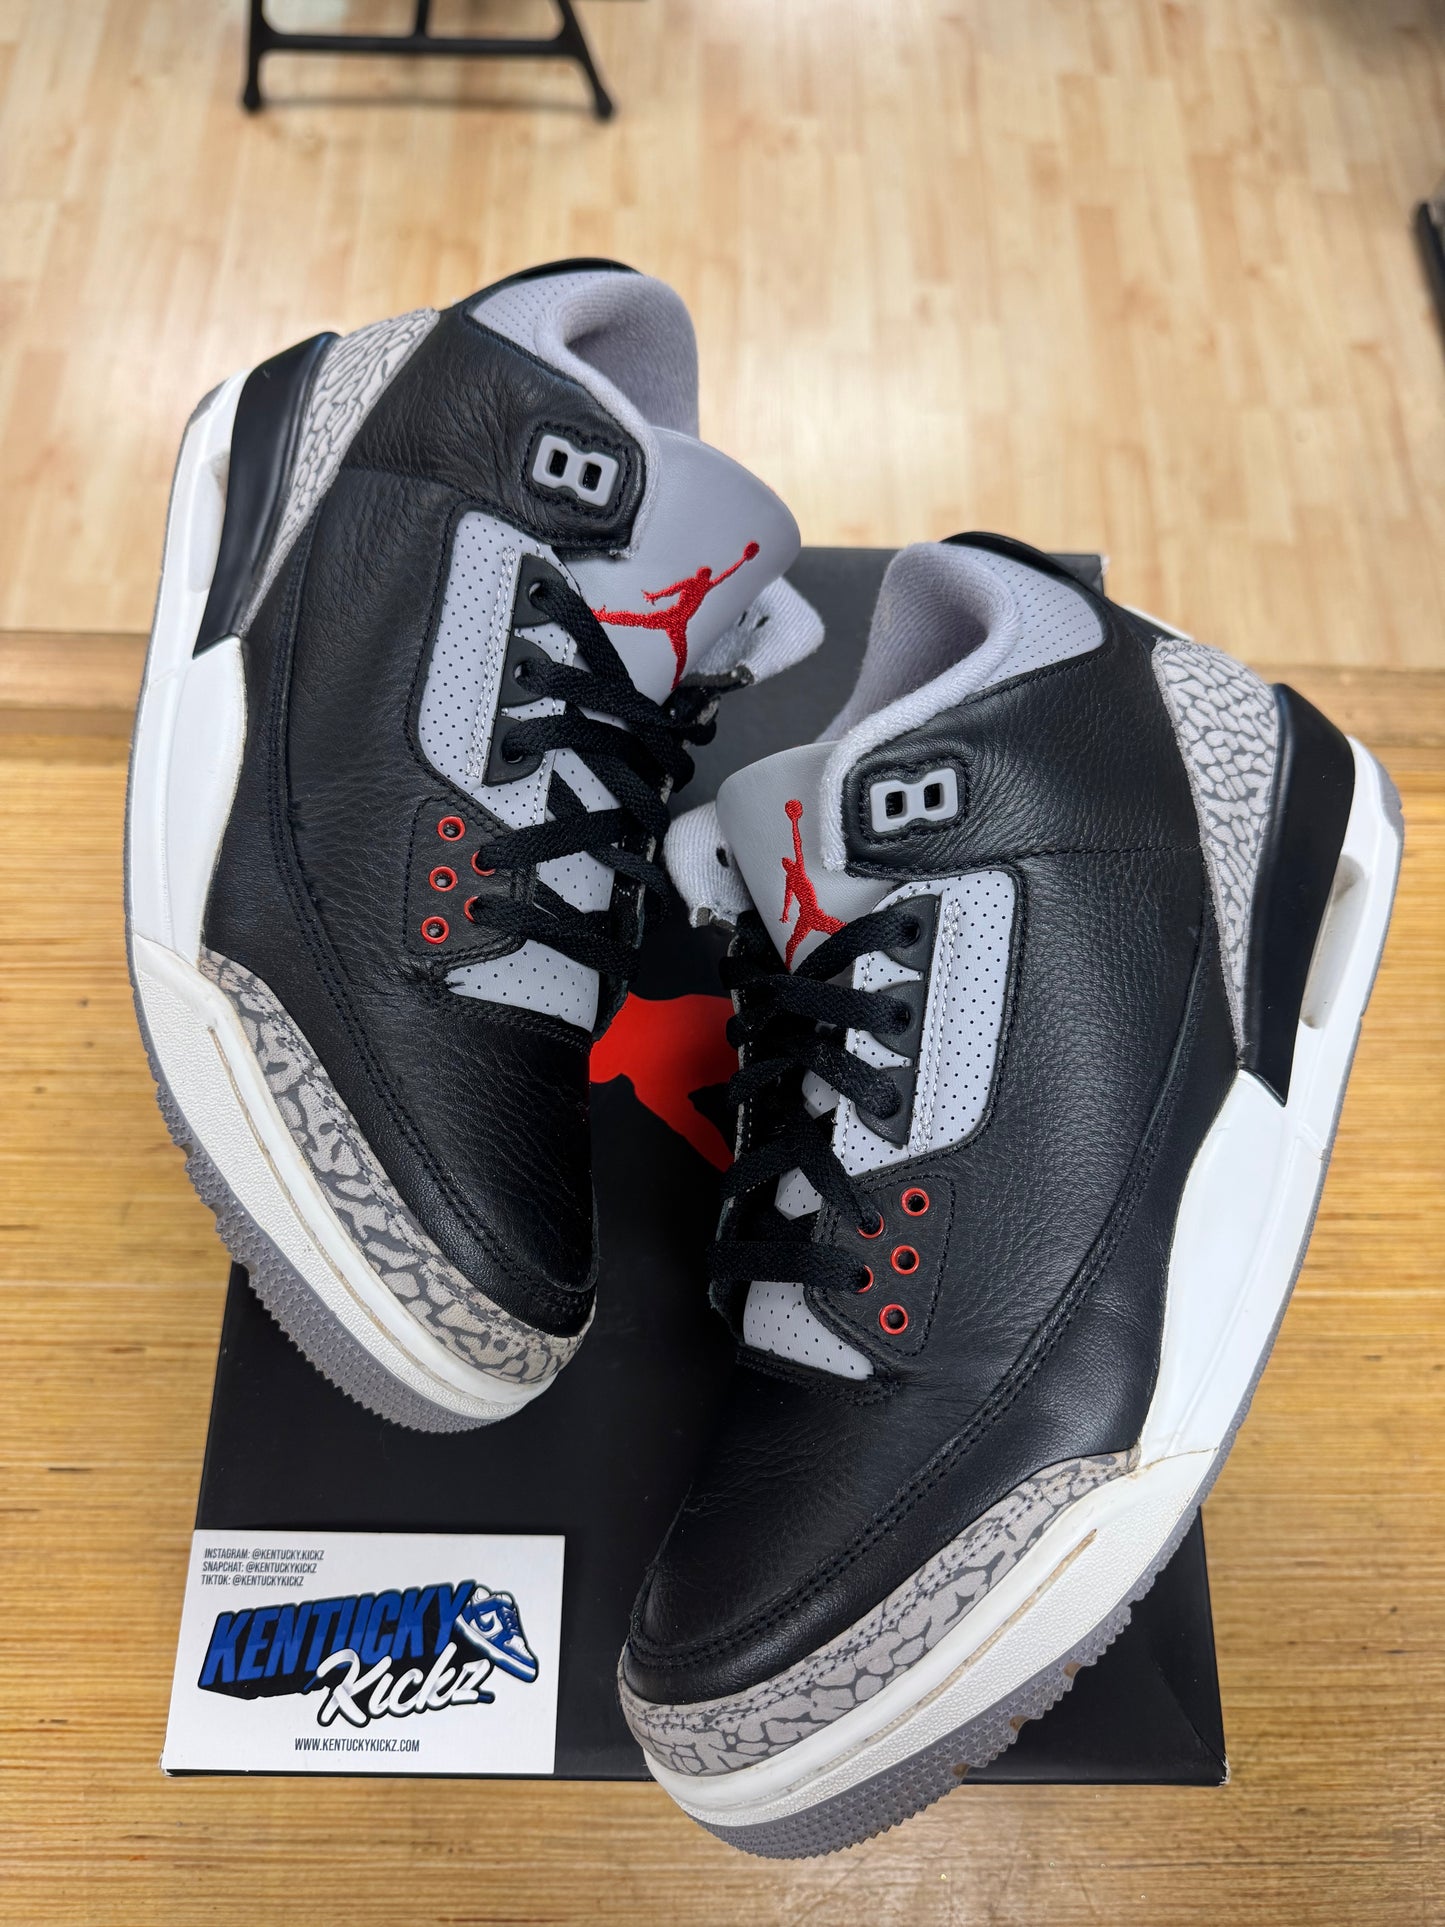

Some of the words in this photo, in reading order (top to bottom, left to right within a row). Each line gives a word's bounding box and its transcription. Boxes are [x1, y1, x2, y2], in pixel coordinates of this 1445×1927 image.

[204, 1548, 250, 1559] INSTAGRAM:
[252, 1548, 325, 1561] @KENTUCKY.KICKZ
[202, 1561, 244, 1573] SNAPCHAT:
[245, 1561, 318, 1574] @KENTUCKYKICKZ
[201, 1574, 231, 1586] TIKTOK:
[232, 1574, 305, 1587] @KENTUCKYKICKZ
[199, 1579, 477, 1687] KENTUCKY
[314, 1641, 491, 1726] Kickz
[294, 1737, 420, 1753] WWW.KENTUCKYKICKZ.COM
